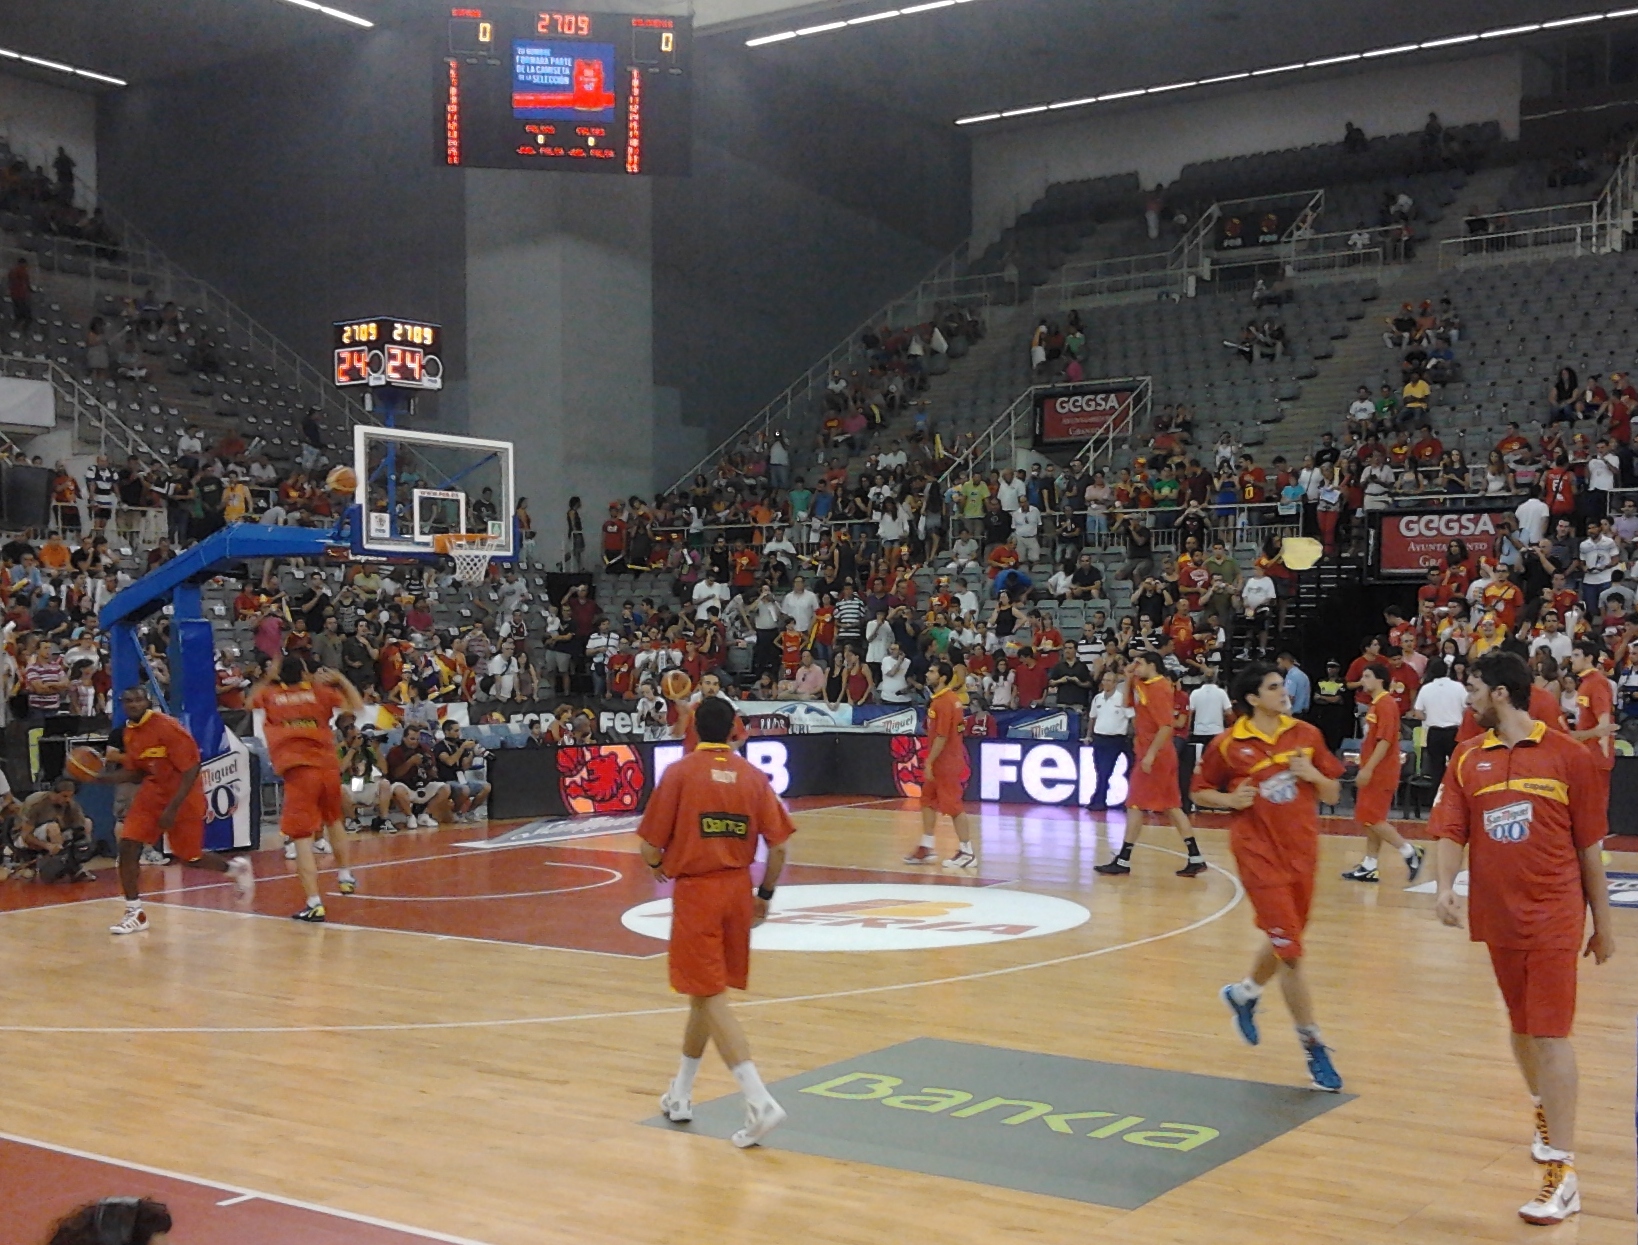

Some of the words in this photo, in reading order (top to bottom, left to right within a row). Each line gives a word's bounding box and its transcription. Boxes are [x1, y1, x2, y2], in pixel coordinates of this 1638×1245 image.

[479, 22, 491, 42] 0
[537, 13, 590, 36] 2709
[662, 33, 673, 52] 0
[338, 351, 367, 382] 24
[387, 348, 420, 380] 24
